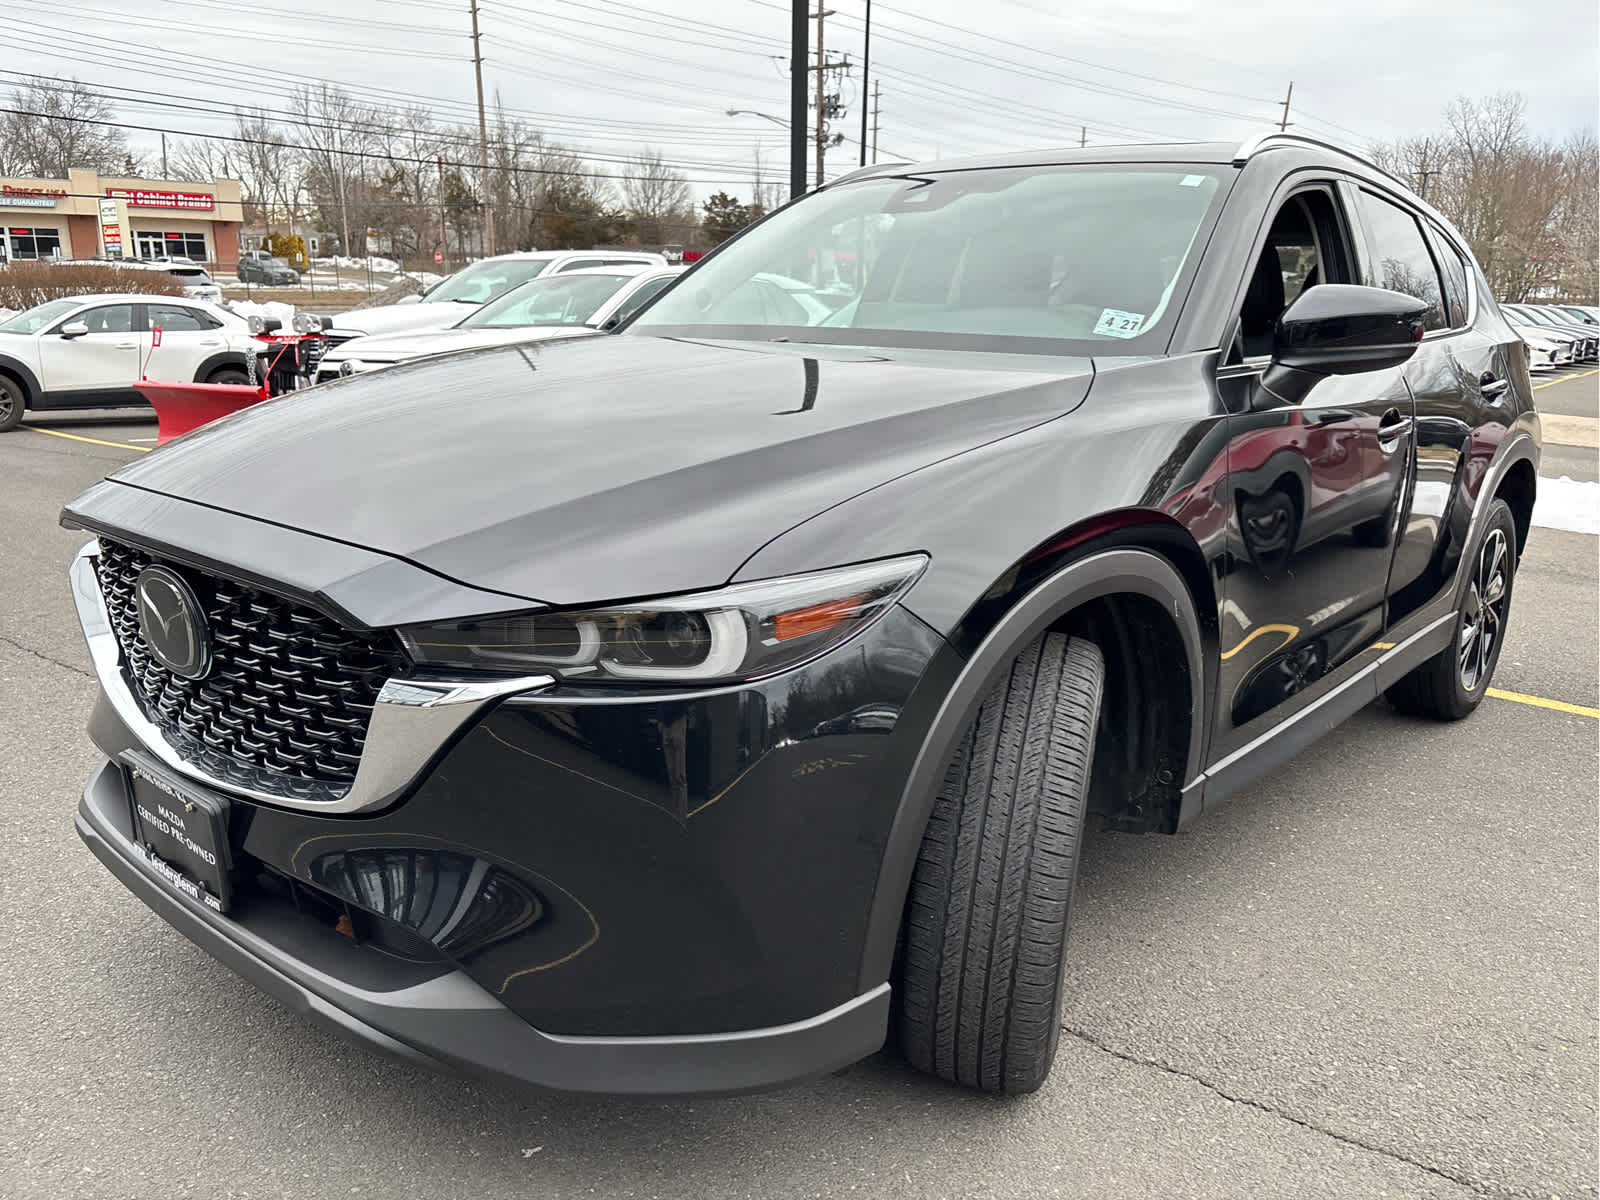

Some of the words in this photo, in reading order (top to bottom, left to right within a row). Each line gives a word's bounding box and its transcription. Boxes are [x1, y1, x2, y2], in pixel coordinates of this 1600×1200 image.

[136, 192, 176, 206] Cabinet
[176, 194, 212, 208] Brands
[1105, 317, 1115, 327] 4
[1119, 319, 1139, 330] 27
[158, 804, 186, 831] MAZDA
[137, 804, 170, 834] CERTIFIED
[170, 826, 216, 865] PRE-OWNED
